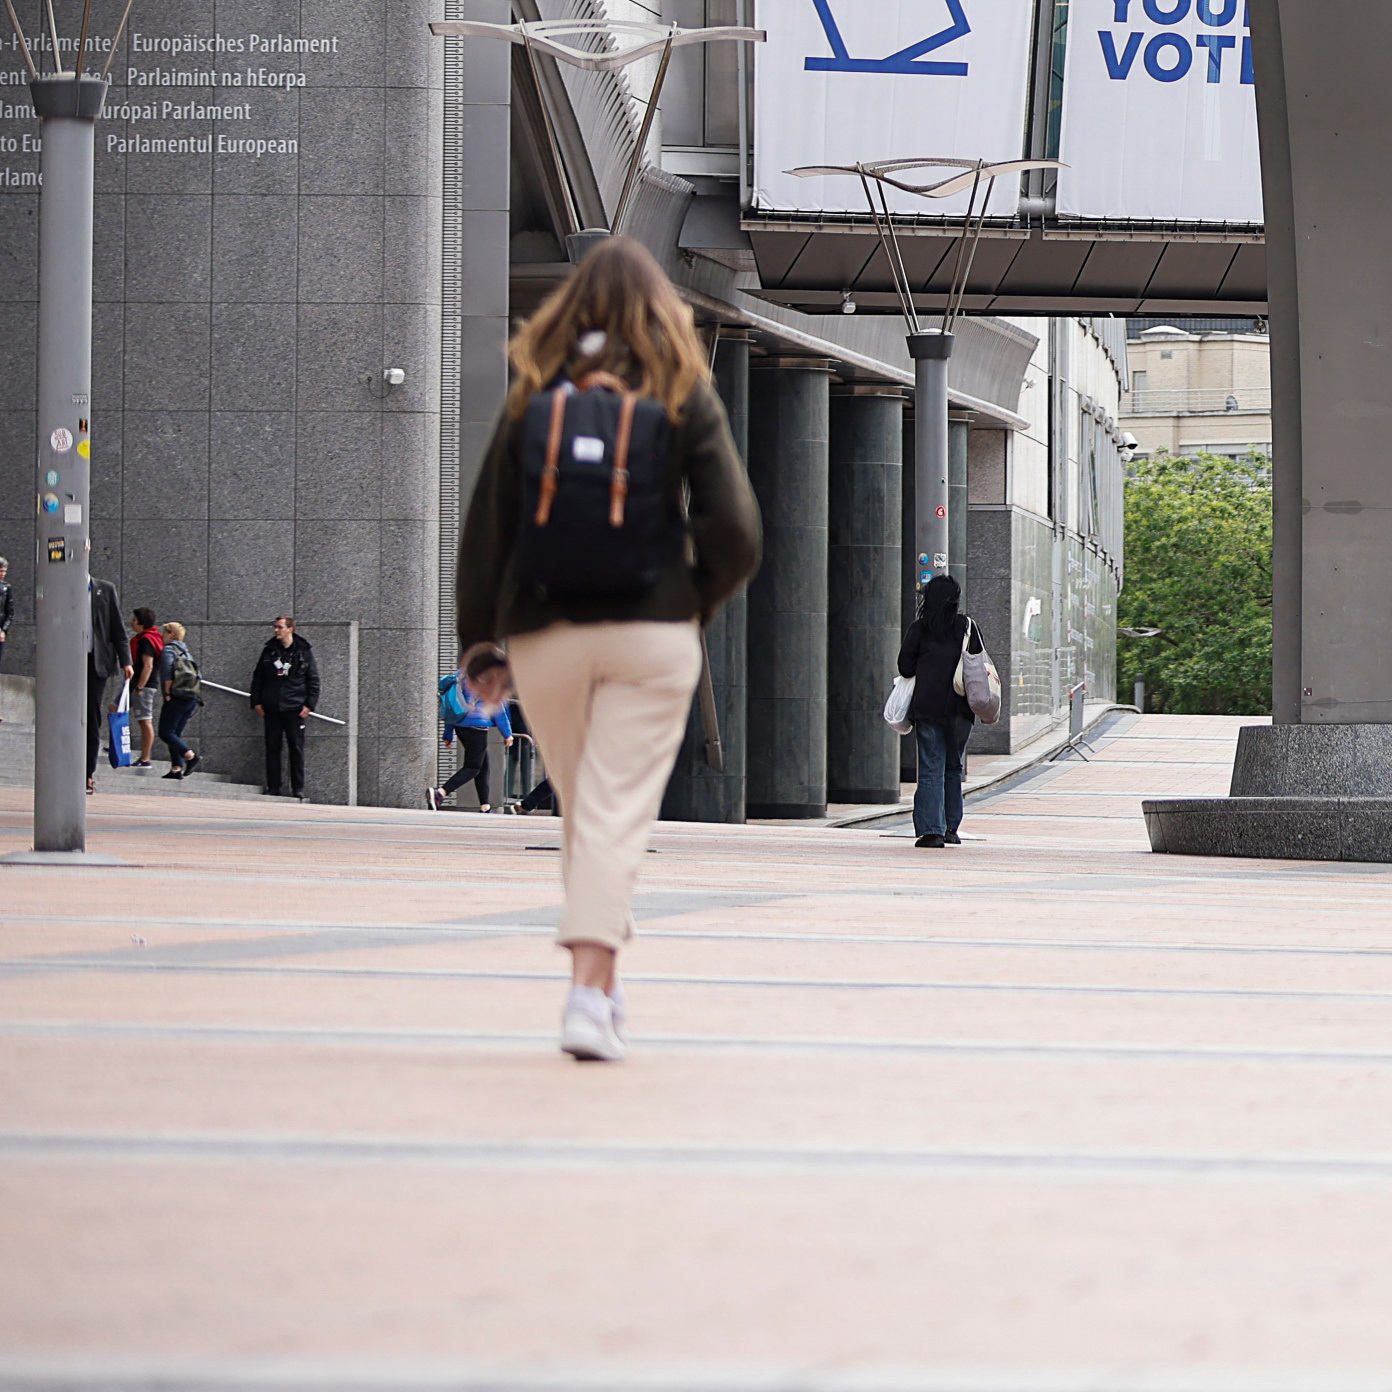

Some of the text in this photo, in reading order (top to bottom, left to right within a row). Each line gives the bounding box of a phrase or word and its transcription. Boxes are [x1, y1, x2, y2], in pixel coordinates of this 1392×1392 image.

[133, 33, 338, 56] Europäisches Parlament
[0, 69, 27, 85] ent
[128, 68, 217, 86] Parlaimint
[222, 73, 241, 86] na
[247, 68, 306, 90] hEorpa
[0, 100, 37, 119] lam
[103, 101, 251, 123] urópai Parlament
[0, 134, 41, 152] to Eu
[107, 134, 298, 157] Parlamentul European
[0, 167, 42, 186] rlam
